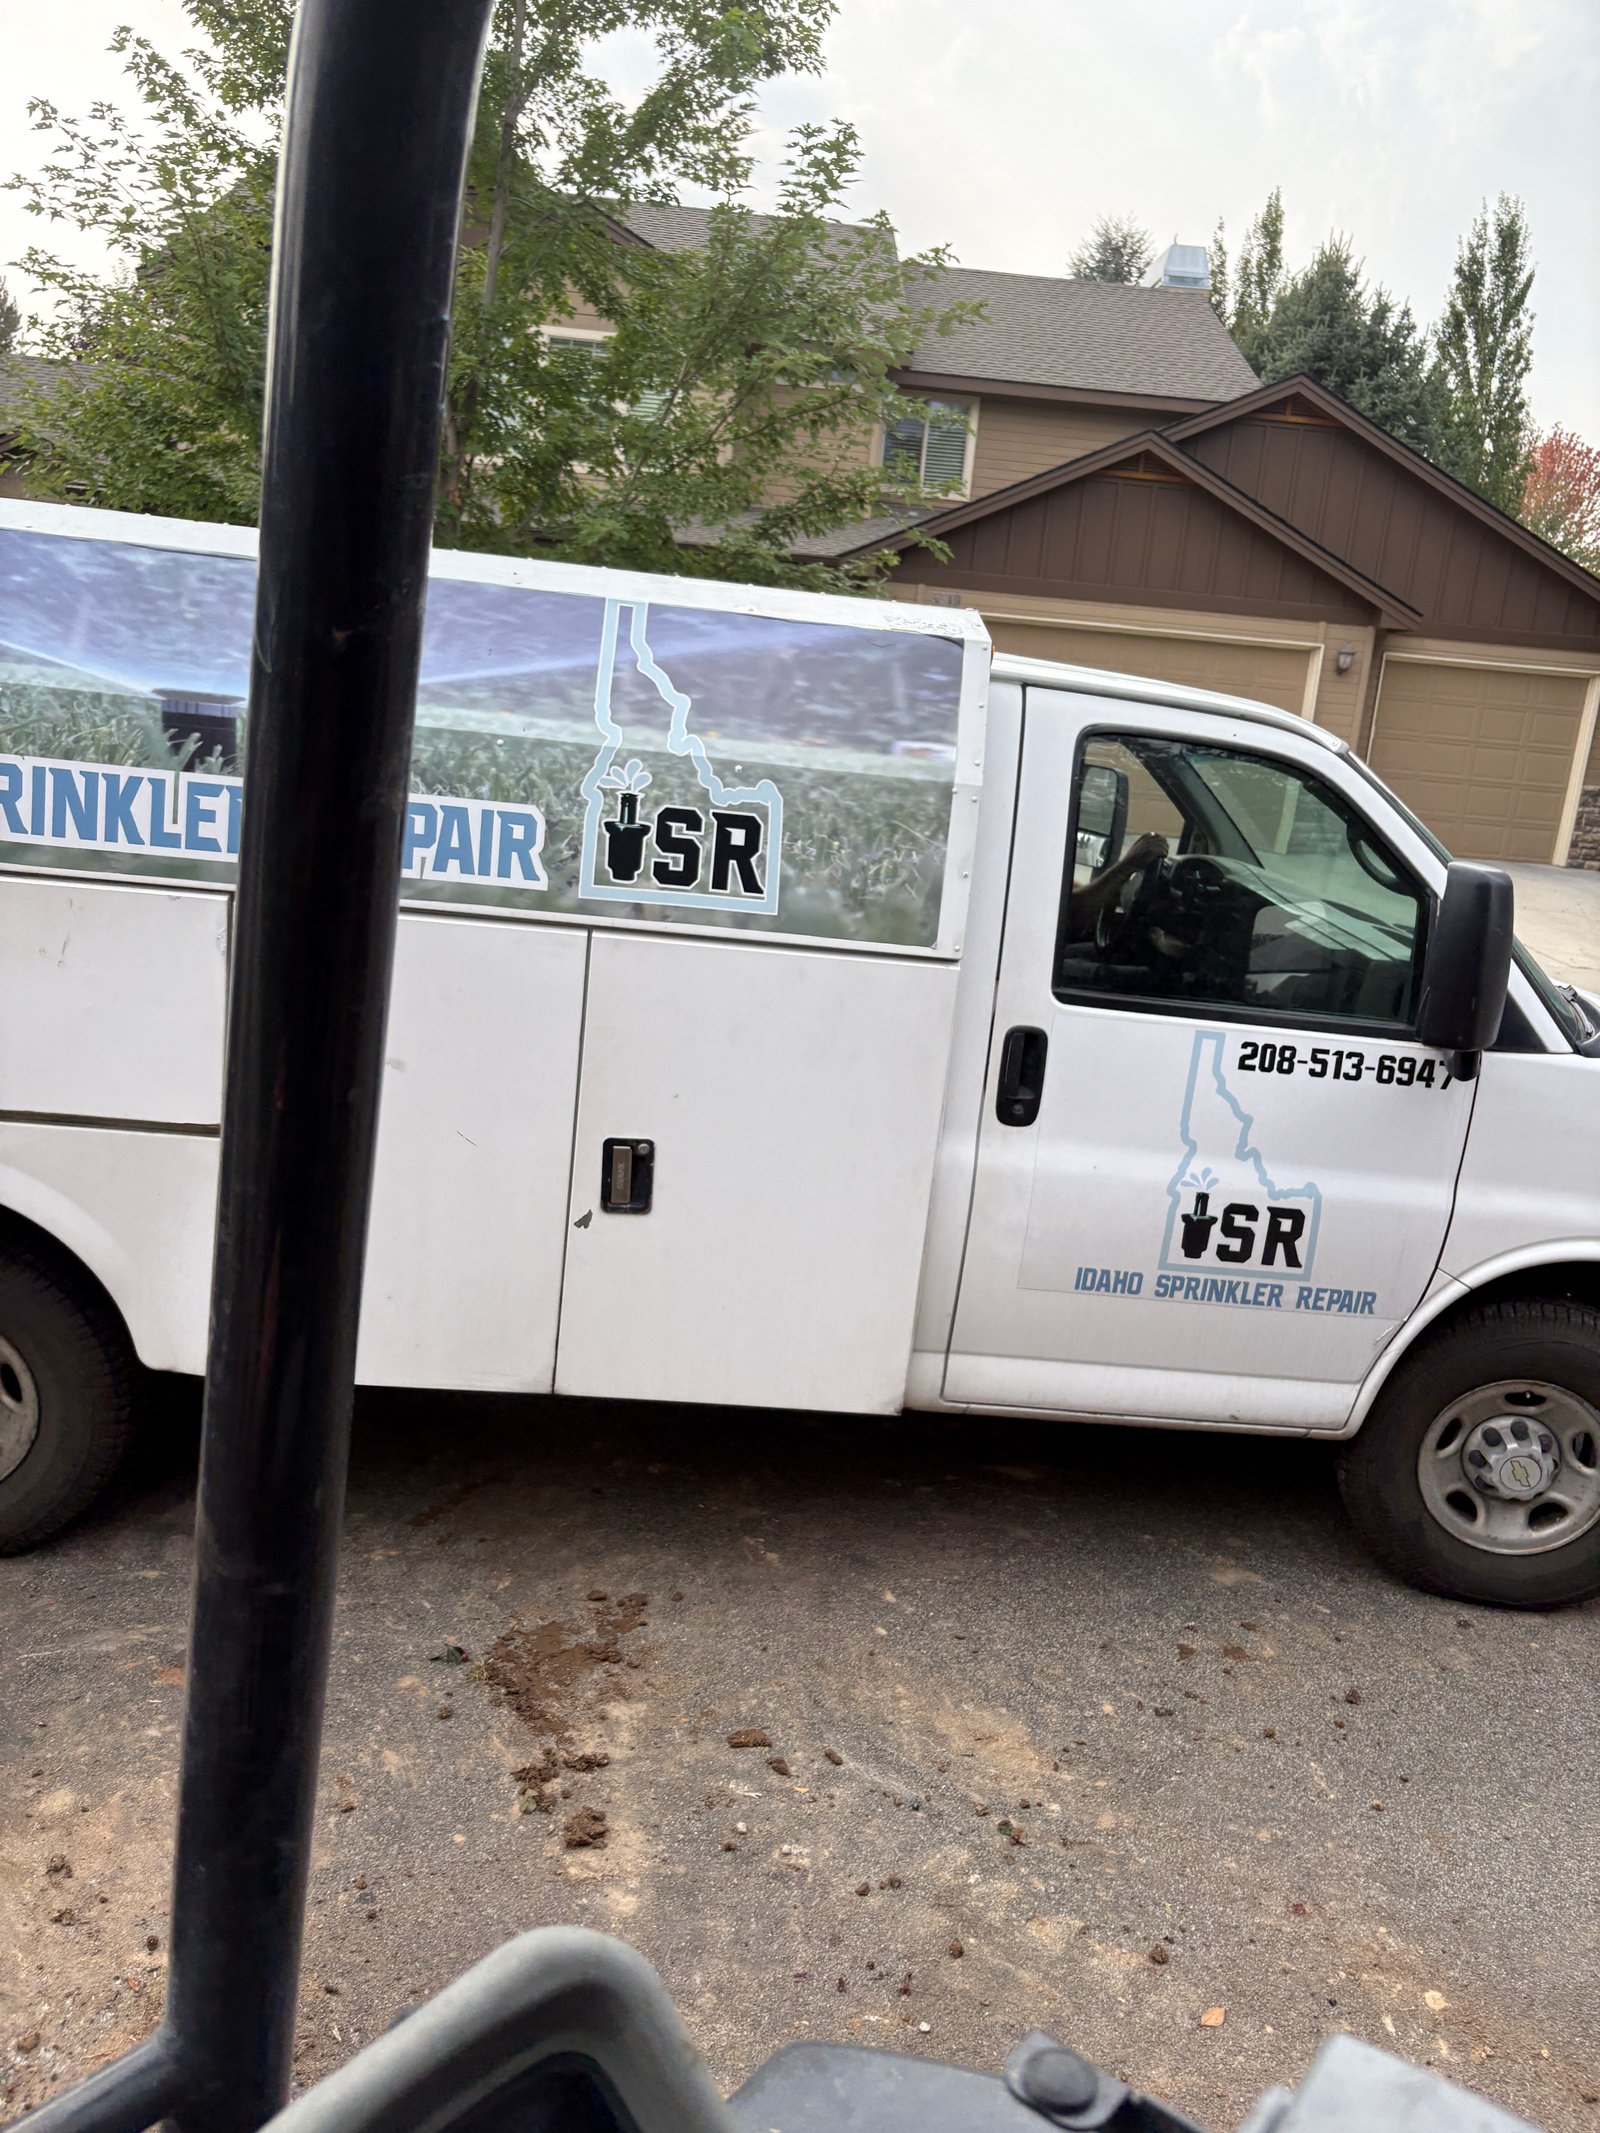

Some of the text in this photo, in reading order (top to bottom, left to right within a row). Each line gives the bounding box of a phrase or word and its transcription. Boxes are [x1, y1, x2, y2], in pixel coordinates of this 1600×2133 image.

[1074, 1267, 1377, 1315] IDAHO SPRINKLER REPAIR
